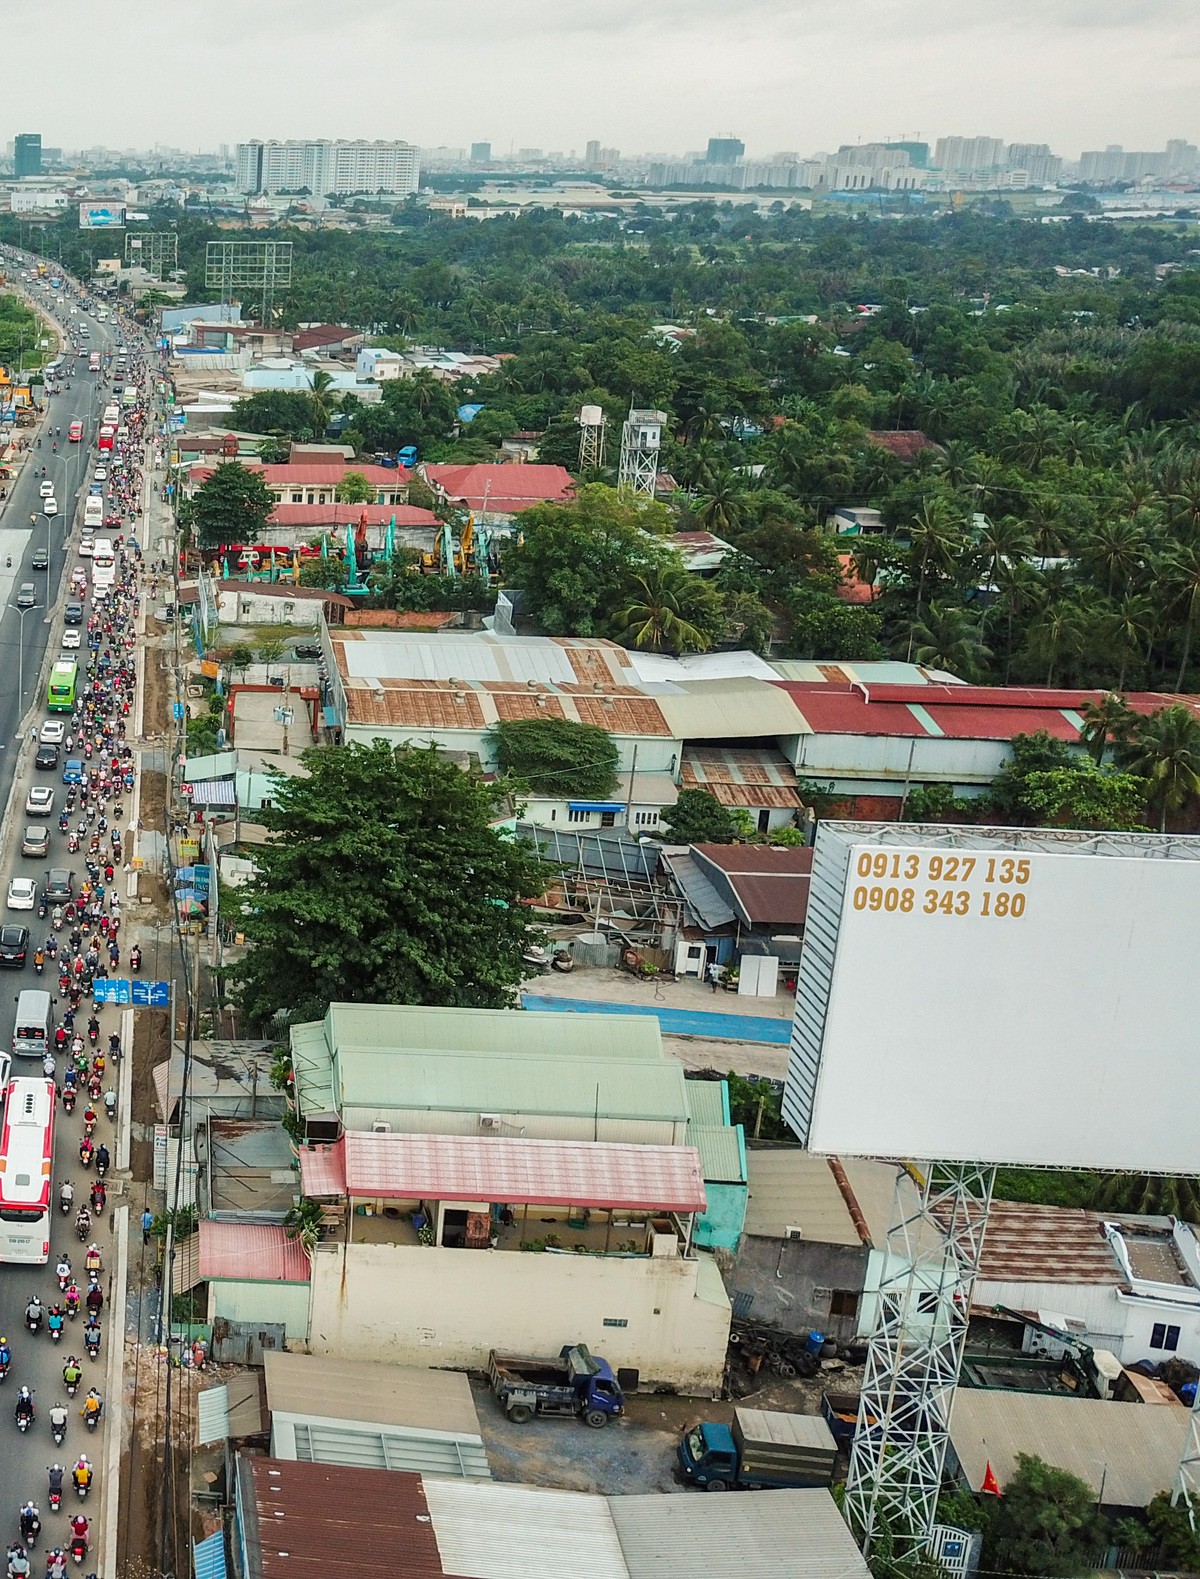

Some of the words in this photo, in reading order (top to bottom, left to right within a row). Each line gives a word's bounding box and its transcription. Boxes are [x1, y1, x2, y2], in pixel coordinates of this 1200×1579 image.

[857, 853, 920, 879] 0913
[928, 856, 976, 882] 927
[985, 858, 1031, 885] 135
[853, 886, 915, 912] 0908
[922, 889, 970, 916] 343
[980, 891, 1026, 918] 180
